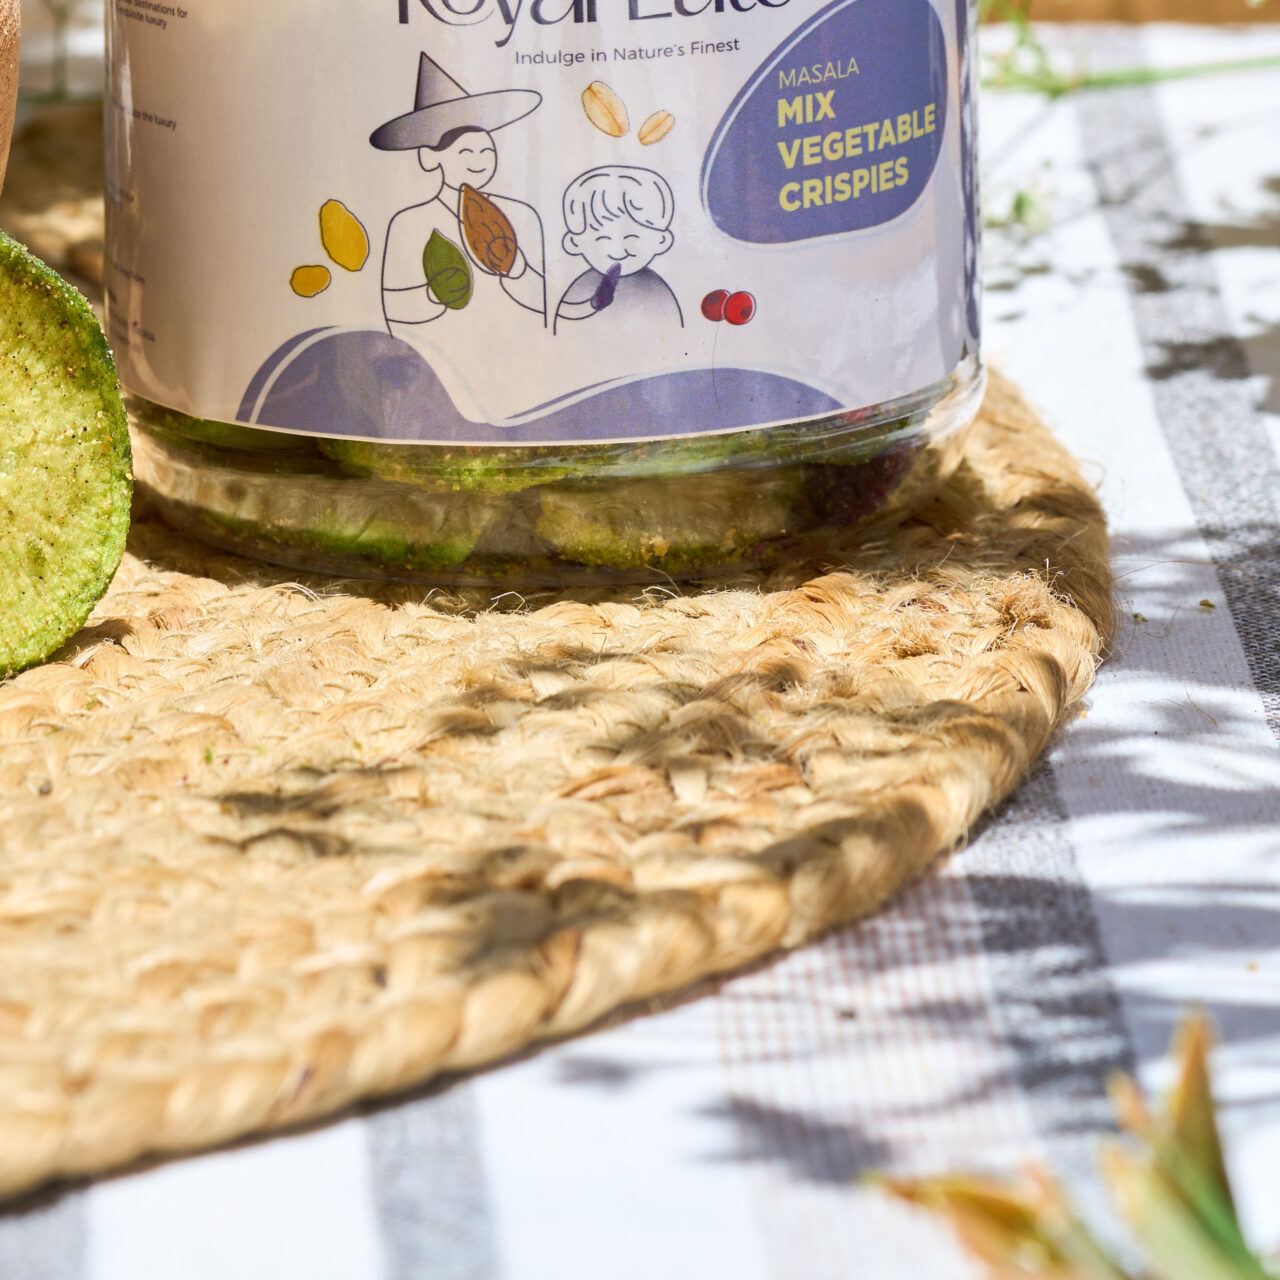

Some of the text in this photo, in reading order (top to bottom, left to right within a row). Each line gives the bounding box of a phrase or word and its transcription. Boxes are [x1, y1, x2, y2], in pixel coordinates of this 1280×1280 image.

[514, 49, 586, 67] Indulge
[591, 47, 608, 63] in
[691, 37, 741, 55] Finest
[778, 57, 860, 89] MASALA
[777, 89, 837, 128] MIX
[777, 103, 937, 169] VEGETABLE
[778, 156, 910, 212] CRISPIES
